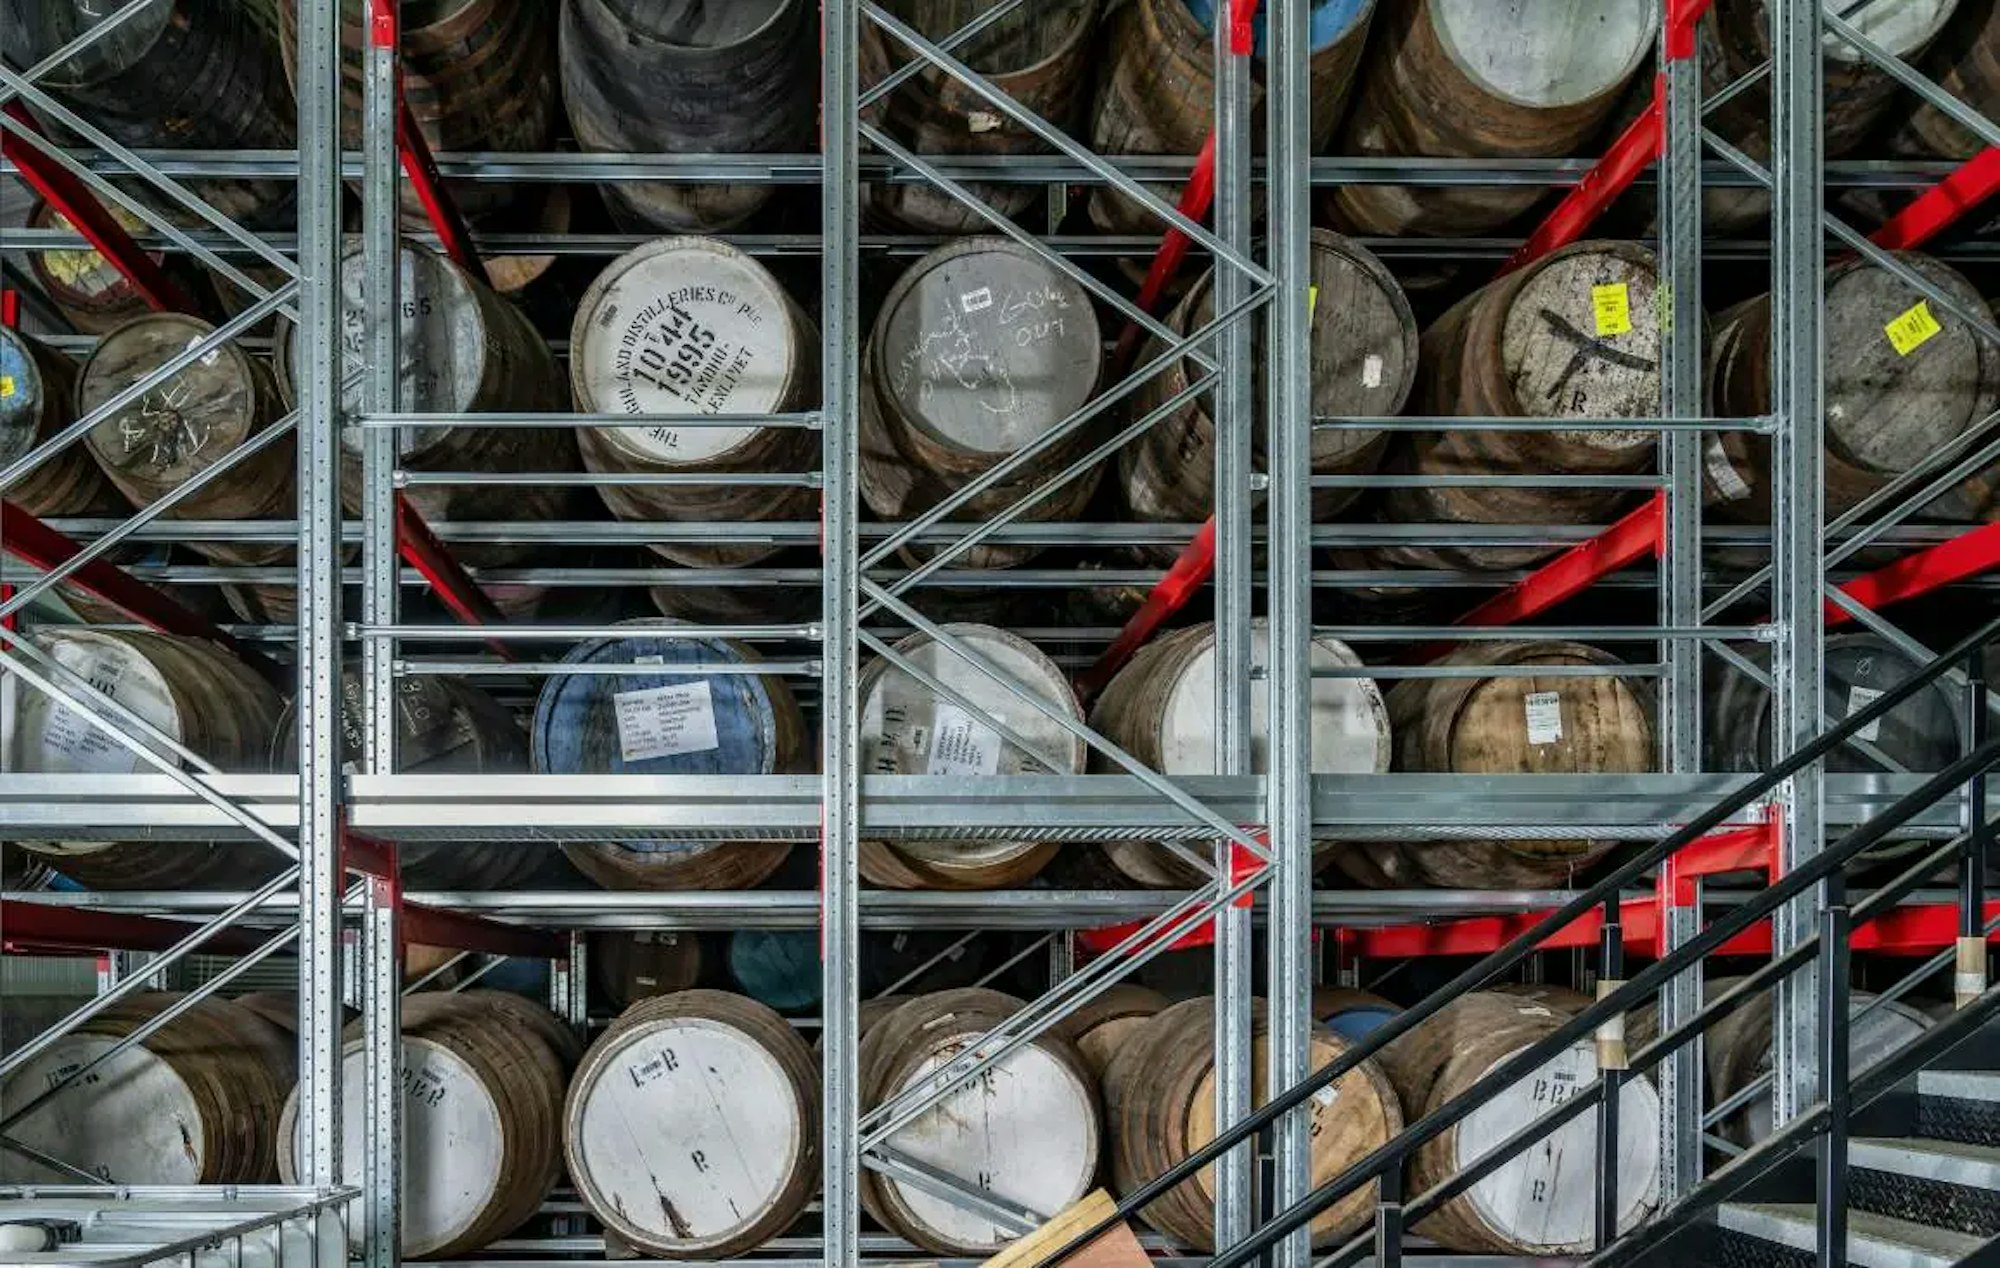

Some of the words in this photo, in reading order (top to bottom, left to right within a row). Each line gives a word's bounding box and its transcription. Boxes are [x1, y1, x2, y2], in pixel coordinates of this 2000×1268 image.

[622, 286, 716, 347] DISTILLERIES
[616, 349, 645, 415] GHLAND
[656, 323, 716, 397] 1995
[701, 345, 754, 416] LENLIVET
[650, 427, 678, 448] THE
